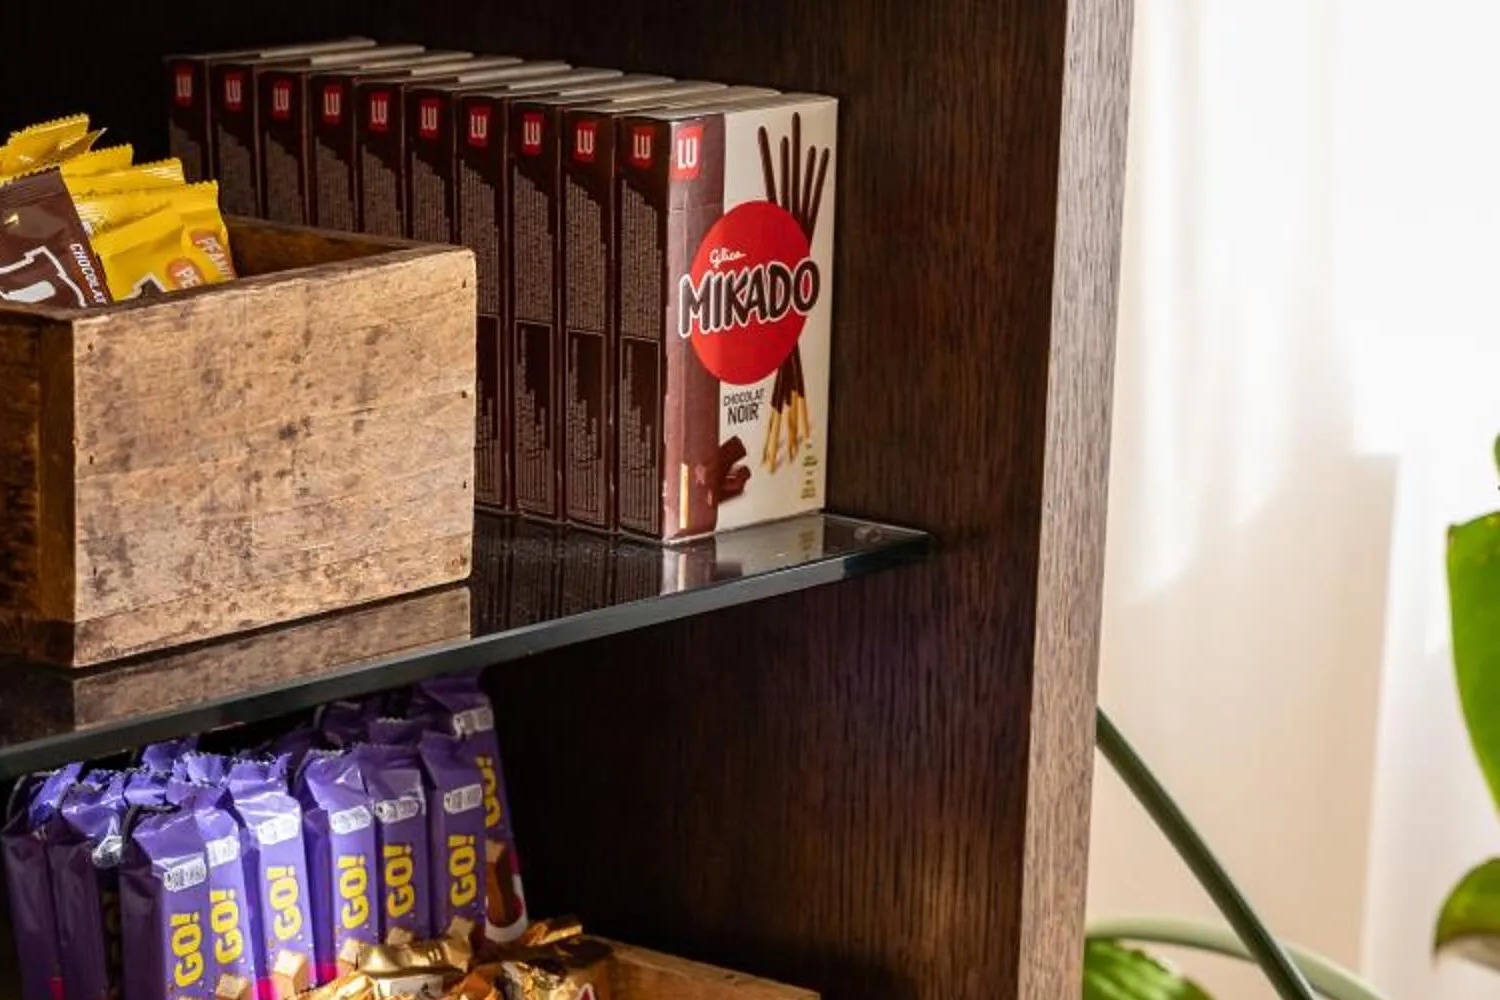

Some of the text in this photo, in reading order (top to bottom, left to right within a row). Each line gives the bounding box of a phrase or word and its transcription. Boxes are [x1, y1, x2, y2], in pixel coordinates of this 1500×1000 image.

[177, 74, 192, 97] LU
[226, 80, 241, 102] LU
[274, 88, 289, 111] LU
[325, 93, 340, 115] LU
[372, 101, 387, 124] LU
[422, 106, 437, 130] LU
[471, 115, 487, 139] LU
[524, 121, 541, 145] LU
[577, 129, 593, 154] LU
[634, 134, 650, 159] LU
[677, 137, 697, 169] LU
[200, 236, 234, 281] PEANU
[679, 258, 820, 338] MIKADO
[723, 387, 765, 407] CHOCOLAT
[727, 404, 760, 425] NOIR
[383, 844, 415, 918] GO!
[448, 834, 478, 908] GO!
[267, 866, 303, 941] GO!
[337, 855, 369, 929] GO!
[210, 888, 244, 965] GO!
[170, 911, 205, 987] GO!
